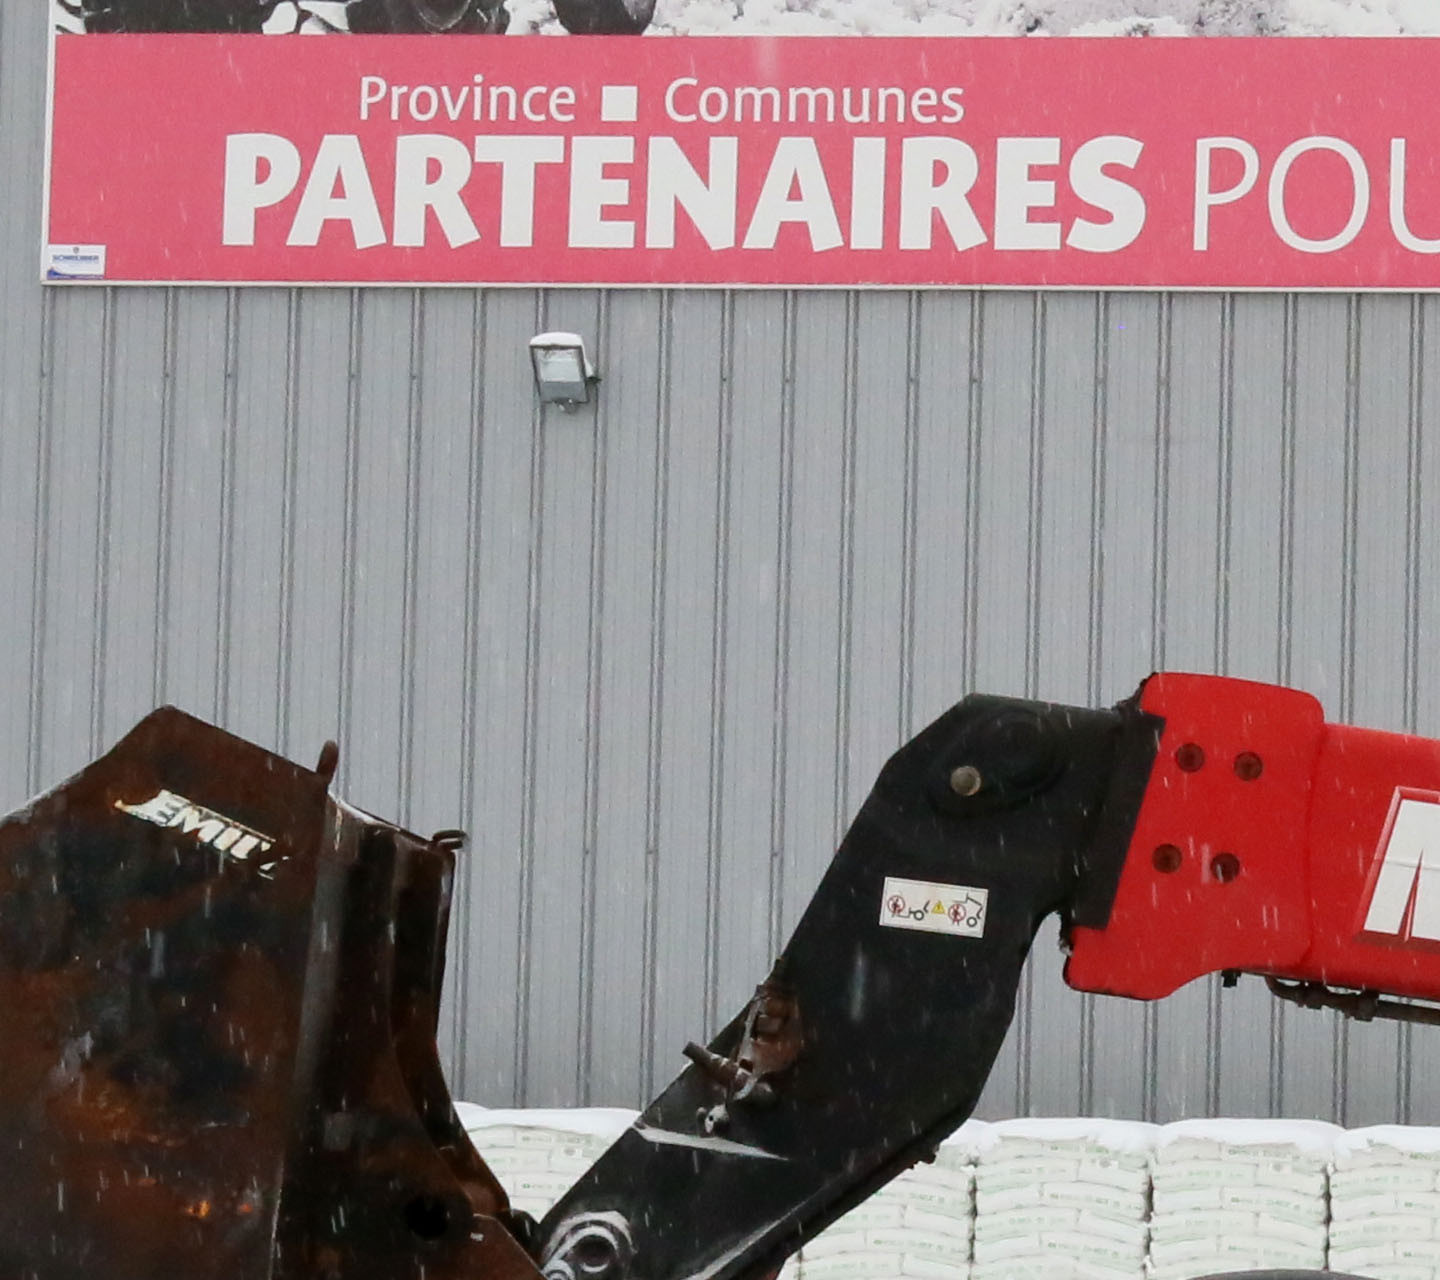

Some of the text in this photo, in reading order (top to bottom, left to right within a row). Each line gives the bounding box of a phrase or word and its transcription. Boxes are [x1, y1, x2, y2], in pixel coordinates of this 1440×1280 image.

[360, 74, 964, 124] Province Communes
[222, 132, 1146, 253] PARTENAIRES
[145, 789, 288, 875] EMIL
